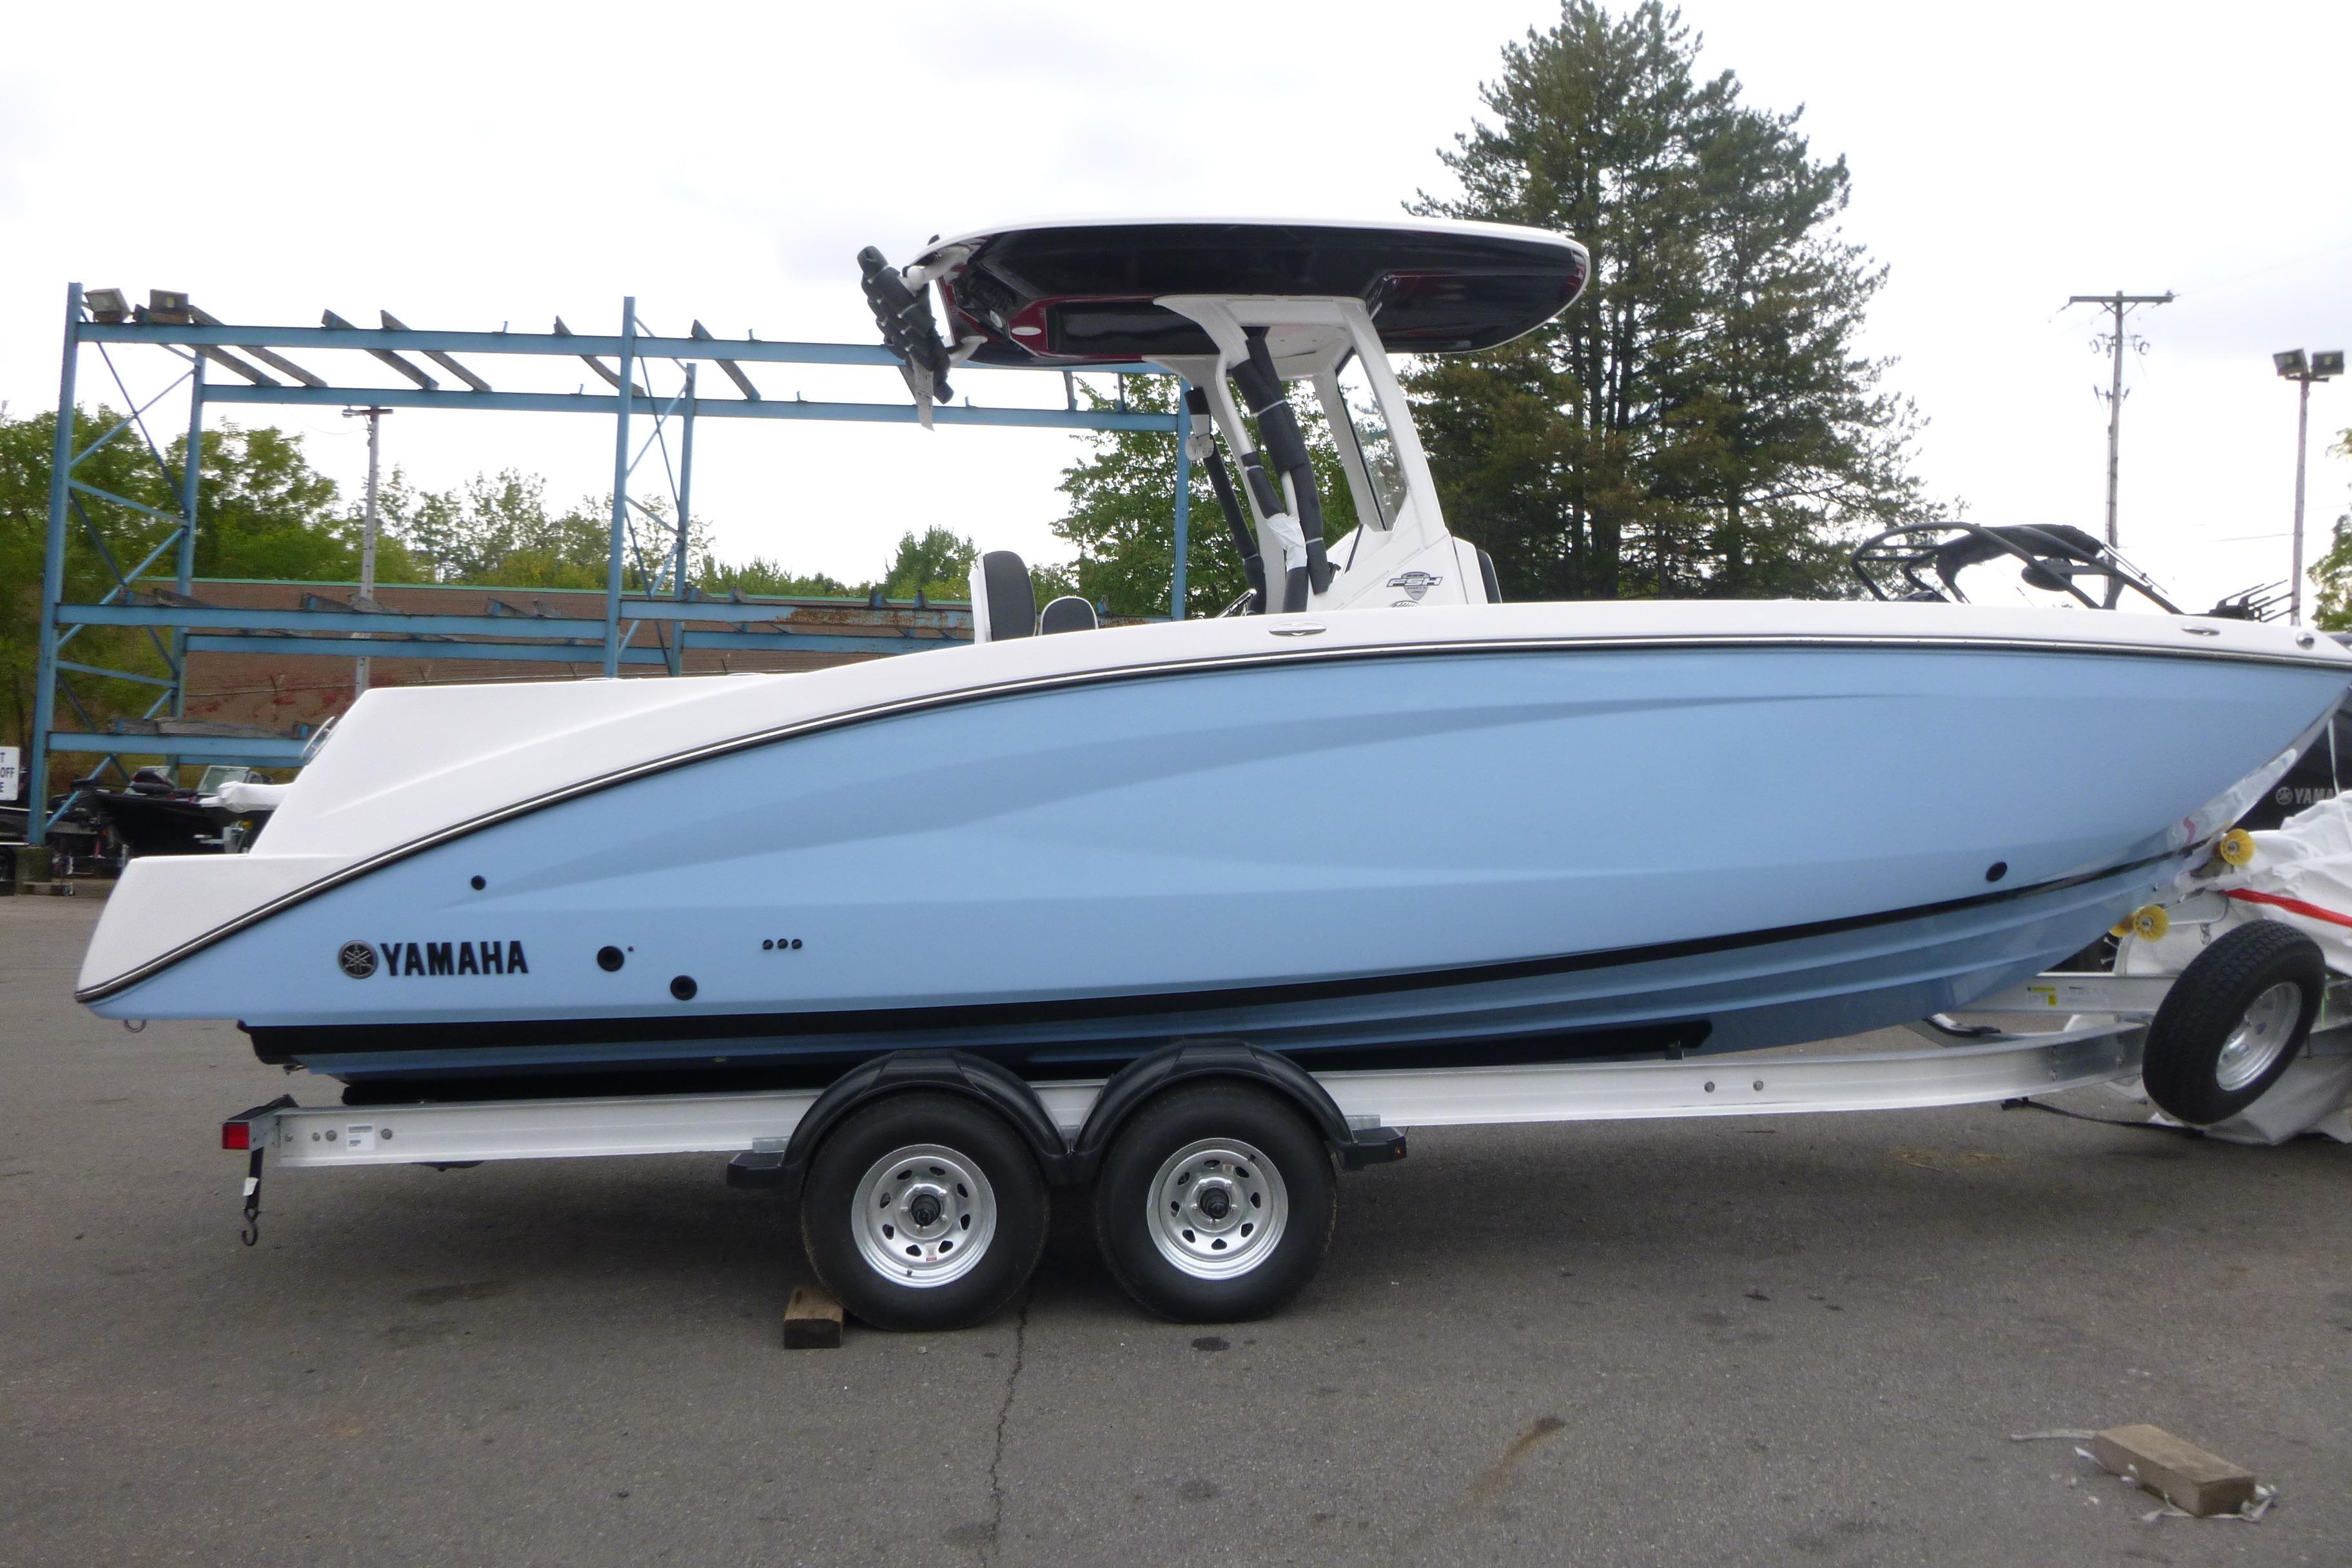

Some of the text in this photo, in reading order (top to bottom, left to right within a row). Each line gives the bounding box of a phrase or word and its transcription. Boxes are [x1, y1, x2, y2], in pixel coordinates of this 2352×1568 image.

[1387, 577, 1442, 587] FSH
[0, 767, 15, 778] OFF
[380, 940, 529, 976] YAMAHA
